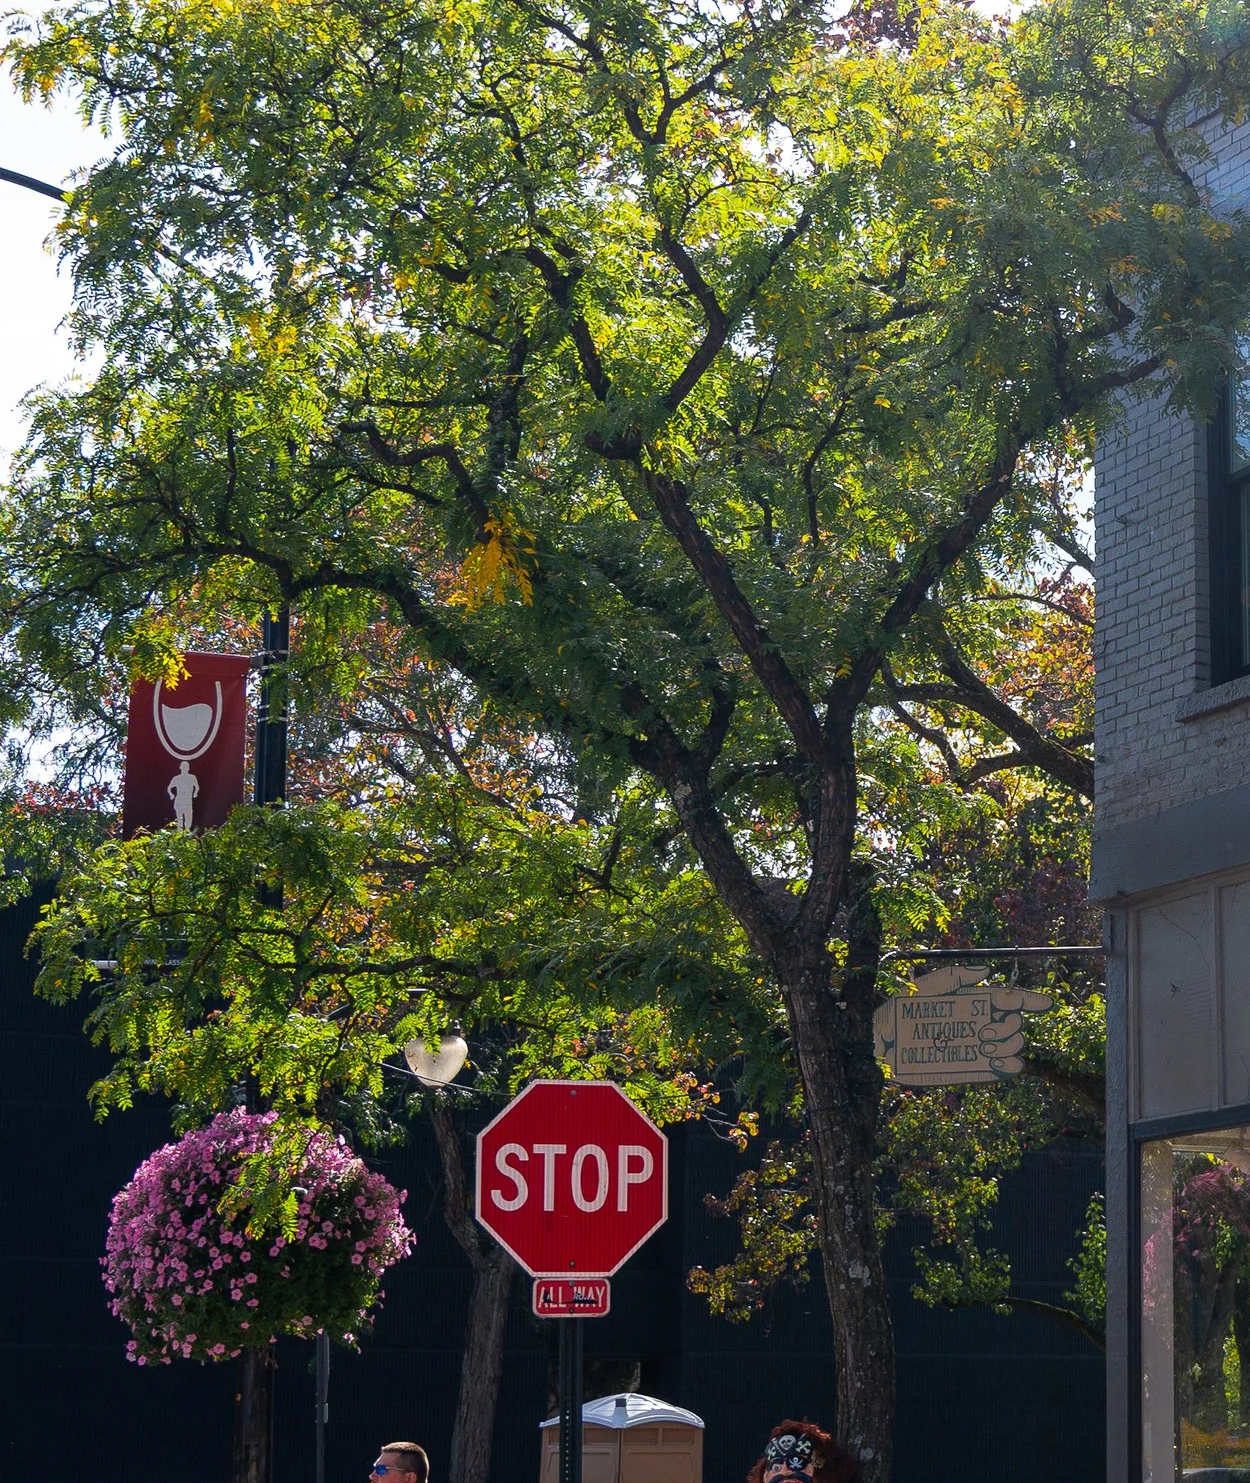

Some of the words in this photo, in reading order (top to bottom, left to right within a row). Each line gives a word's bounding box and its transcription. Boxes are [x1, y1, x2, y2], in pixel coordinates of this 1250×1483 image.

[902, 1001, 955, 1019] MARKET
[971, 999, 989, 1017] ST.
[913, 1021, 977, 1040] ANTIQUES
[901, 1044, 979, 1064] COLLECTIBLES
[933, 1037, 955, 1053] &
[491, 1143, 654, 1212] STOP
[538, 1286, 567, 1308] ALL
[573, 1286, 605, 1308] WAY
